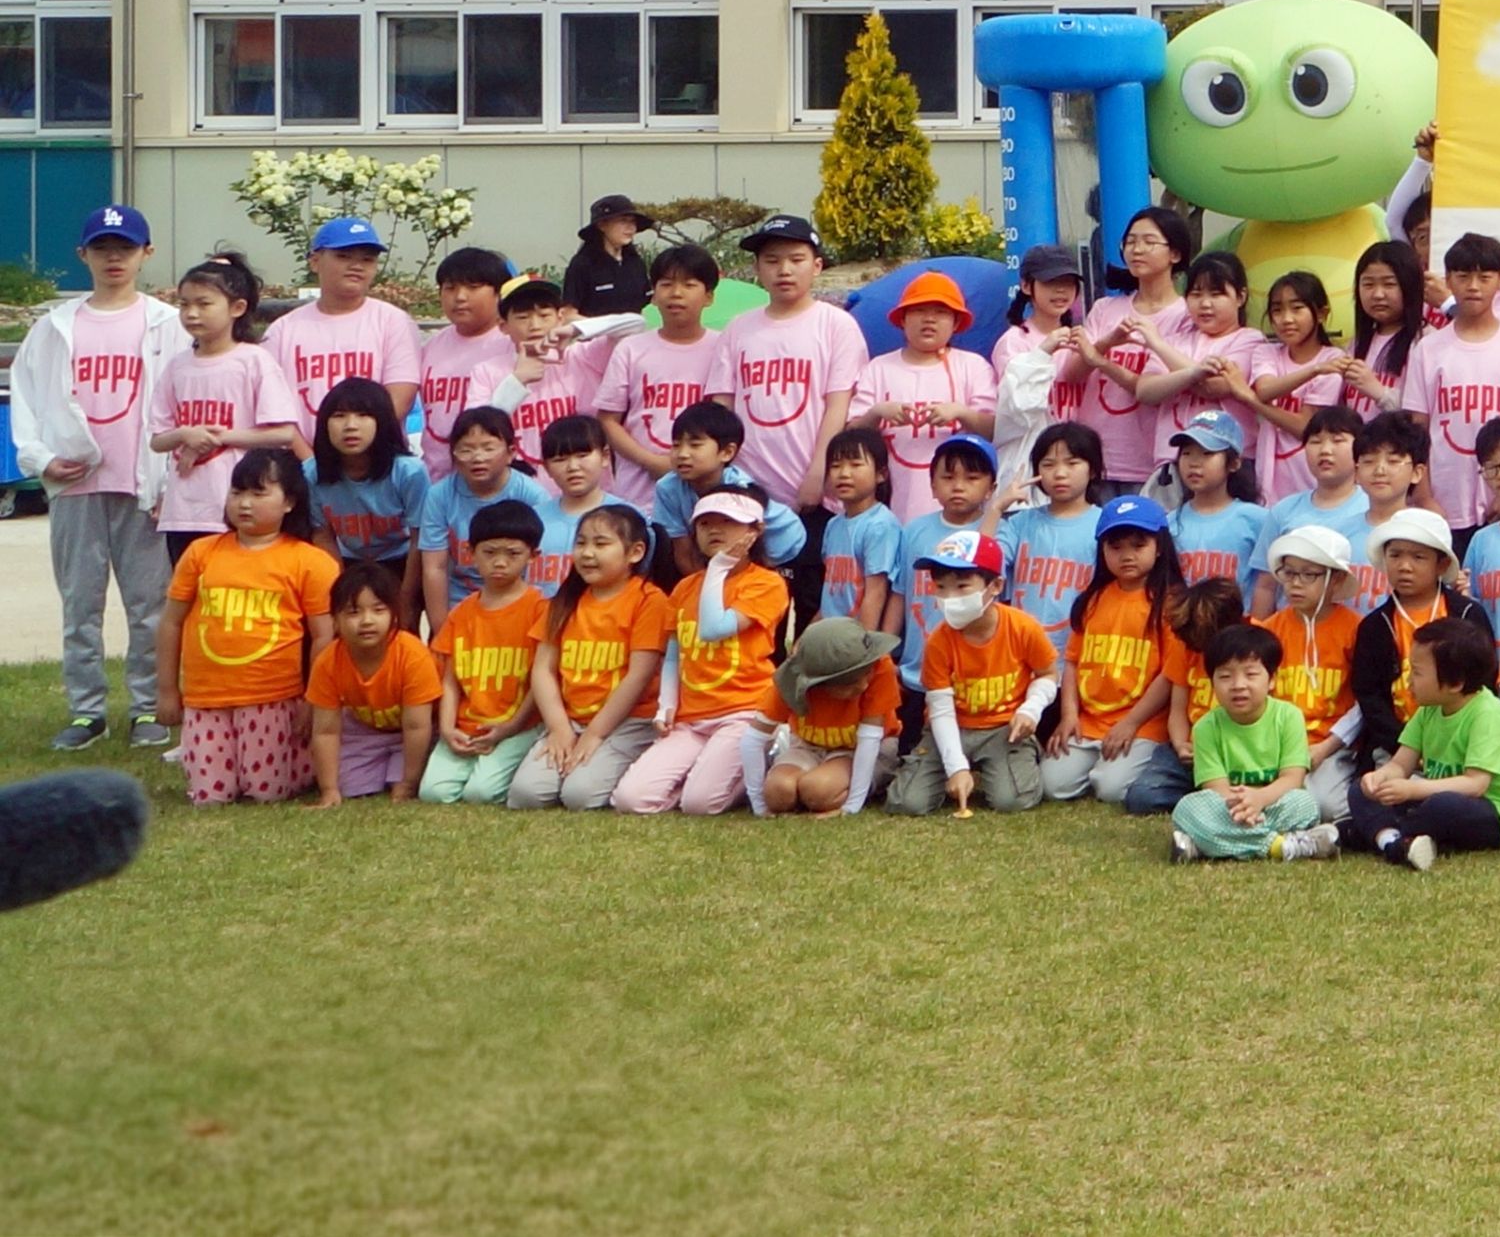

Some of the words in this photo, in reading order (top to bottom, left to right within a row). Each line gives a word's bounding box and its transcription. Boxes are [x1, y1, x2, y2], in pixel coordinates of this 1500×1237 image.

[103, 207, 123, 226] LA
[74, 354, 143, 393] appy
[295, 345, 373, 391] happy
[424, 366, 471, 415] happ
[741, 352, 812, 397] happy
[643, 373, 703, 419] happ
[1016, 542, 1093, 598] happy
[562, 639, 625, 683] appy
